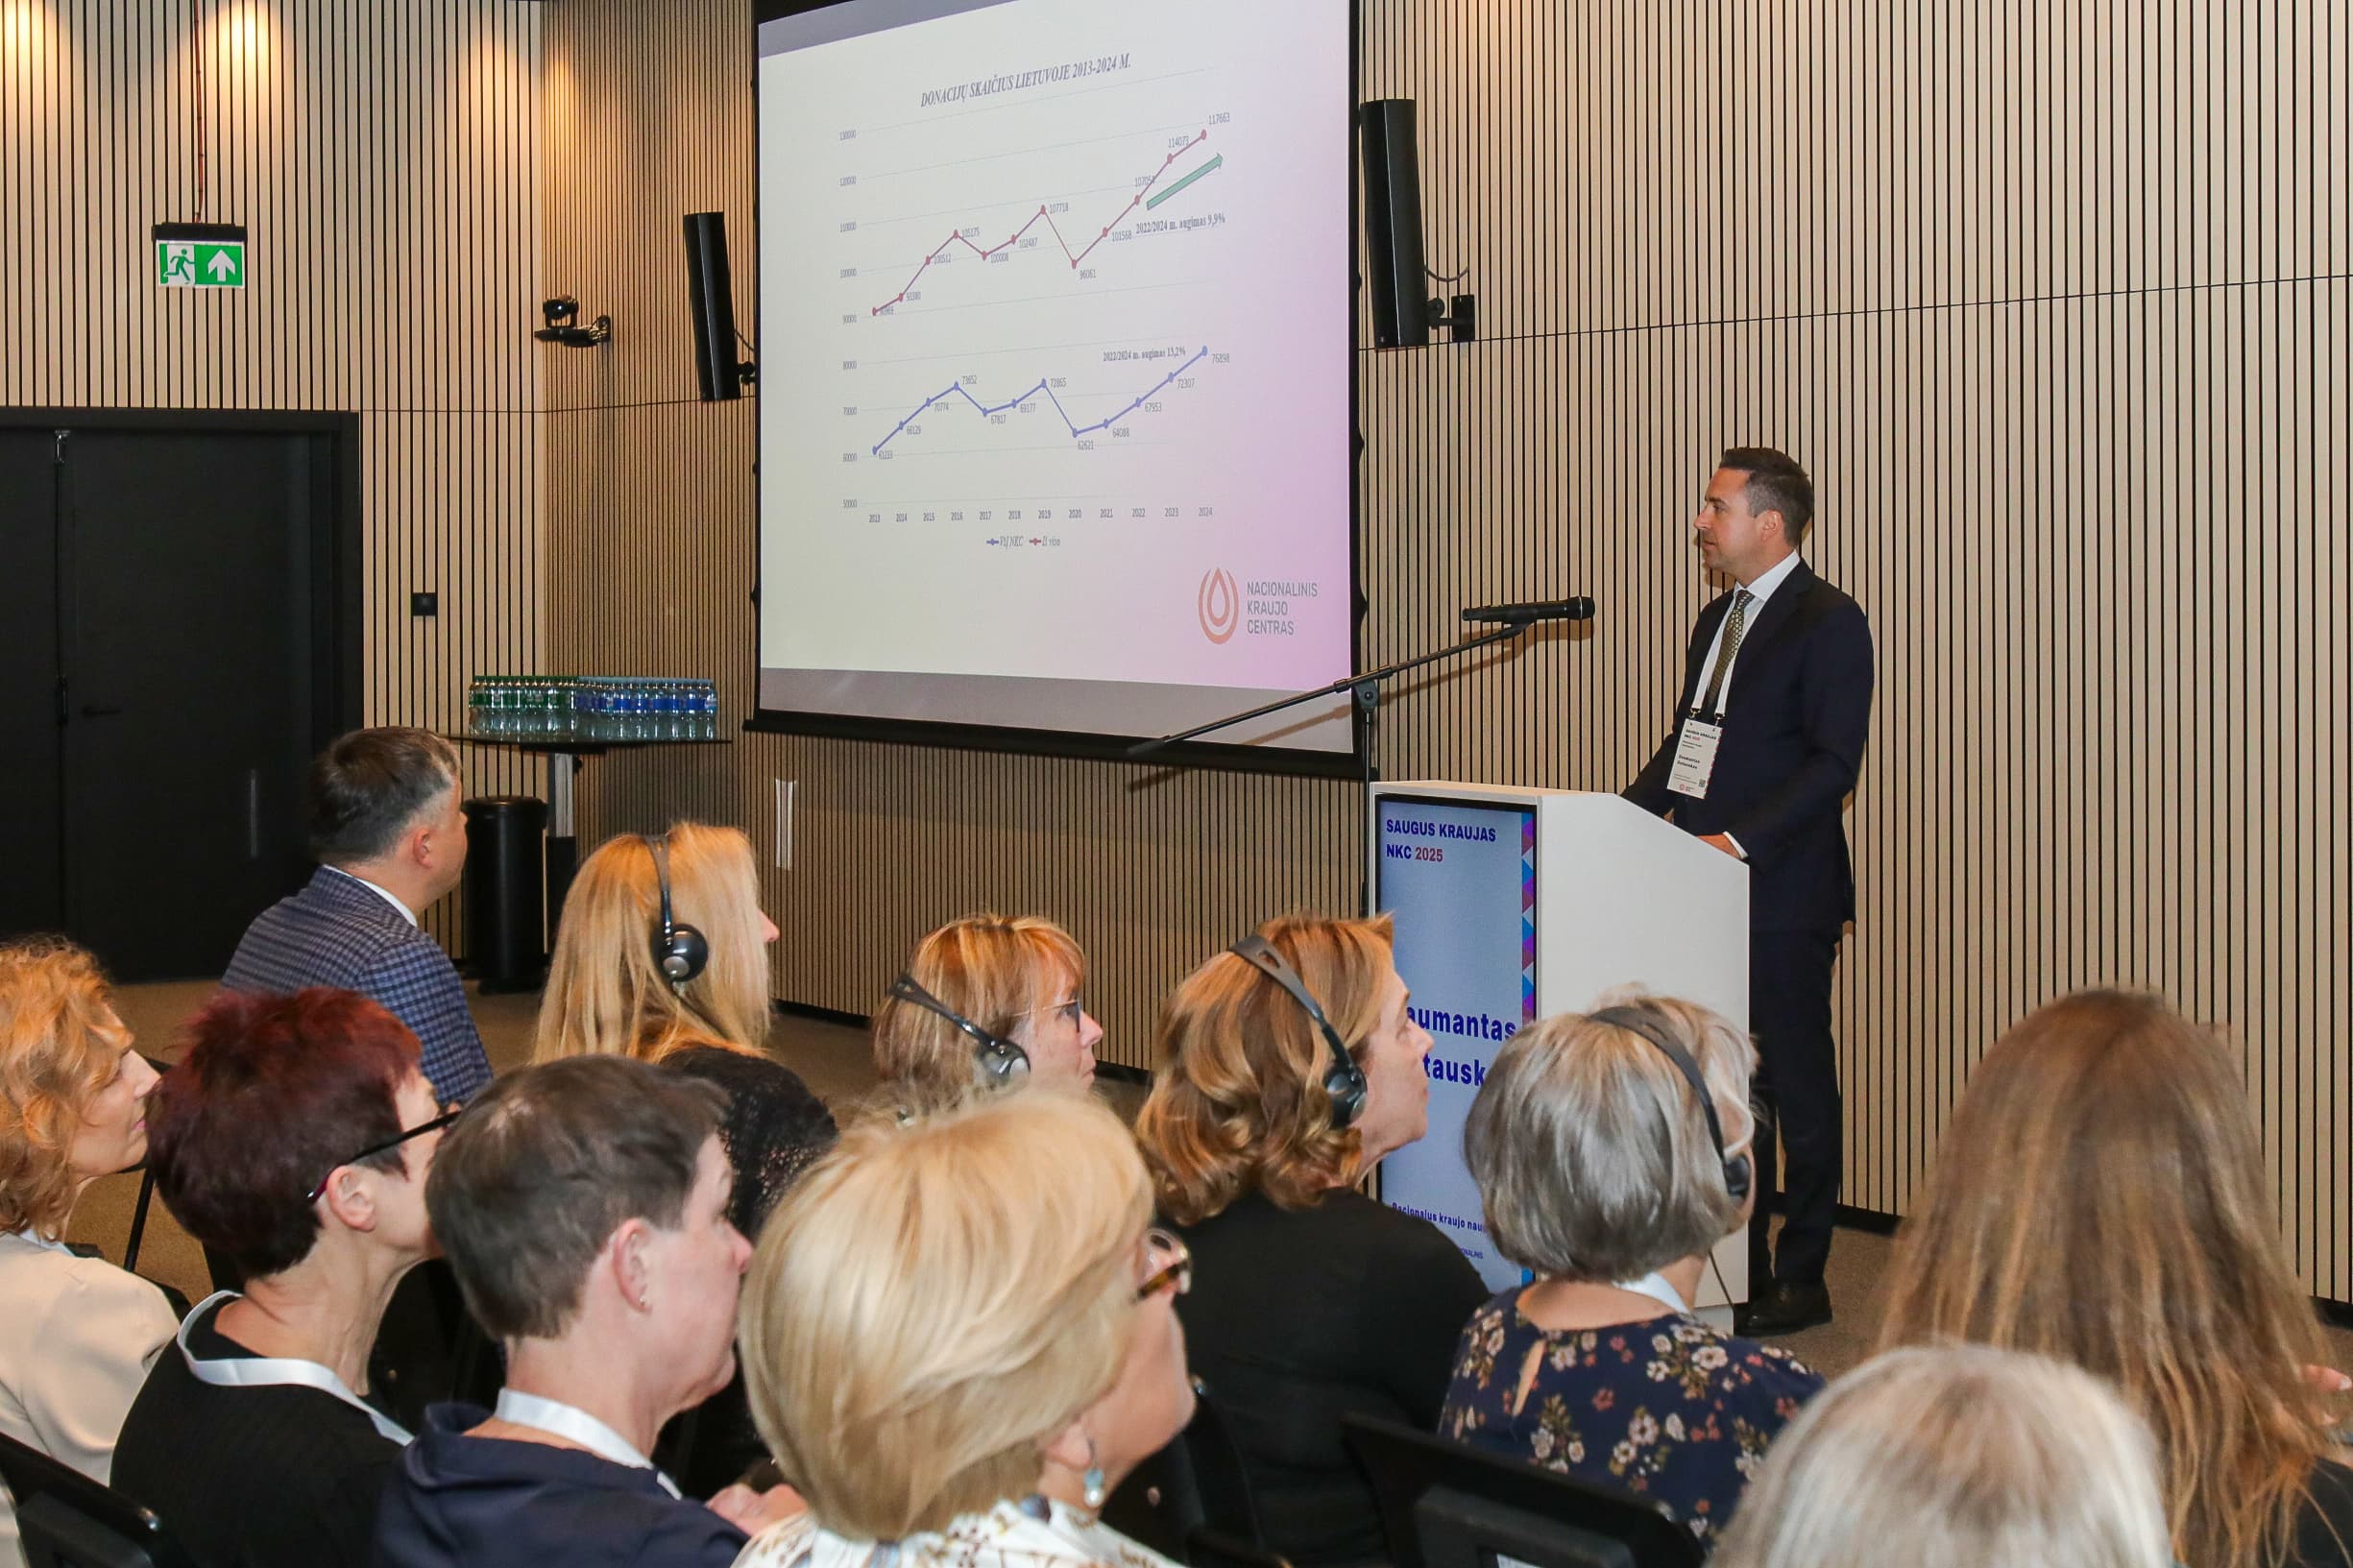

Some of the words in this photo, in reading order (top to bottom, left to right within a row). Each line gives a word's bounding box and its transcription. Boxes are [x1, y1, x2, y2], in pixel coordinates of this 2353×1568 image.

[921, 84, 969, 108] DONACIJŲ
[969, 74, 1014, 98] SKAIČIUS
[1015, 64, 1072, 89] LIETUVOJE
[1072, 57, 1118, 79] 2013-2024
[1118, 53, 1131, 69] M.
[1135, 220, 1168, 234] 2022/2024
[1169, 221, 1177, 230] m.
[1178, 216, 1207, 230] augimas
[1207, 212, 1225, 227] 9,9%
[868, 514, 881, 523] 2013
[895, 513, 908, 522] 2014
[922, 512, 935, 522] 2015
[951, 511, 963, 521] 2016
[979, 511, 992, 520] 2017
[1008, 510, 1022, 520] 2018
[1037, 509, 1052, 519] 2019
[1068, 509, 1082, 519] 2020
[1100, 508, 1114, 519] 2021
[1131, 507, 1146, 518] 2022
[1164, 507, 1179, 518] 2023
[1198, 506, 1213, 517] 2024
[1247, 580, 1318, 597] NACIONALINIS
[1247, 600, 1288, 615] KRAUJO
[1247, 619, 1295, 636] CENTRAS
[1386, 819, 1435, 836] SAUGUS
[1440, 823, 1496, 842] KRAUJAS
[1386, 843, 1412, 859] NKC
[1415, 846, 1443, 862] 2025
[1406, 1006, 1516, 1042] aumantas
[1422, 1052, 1487, 1087] tausk
[1439, 1212, 1466, 1229] kraujo
[1467, 1220, 1484, 1233] nau
